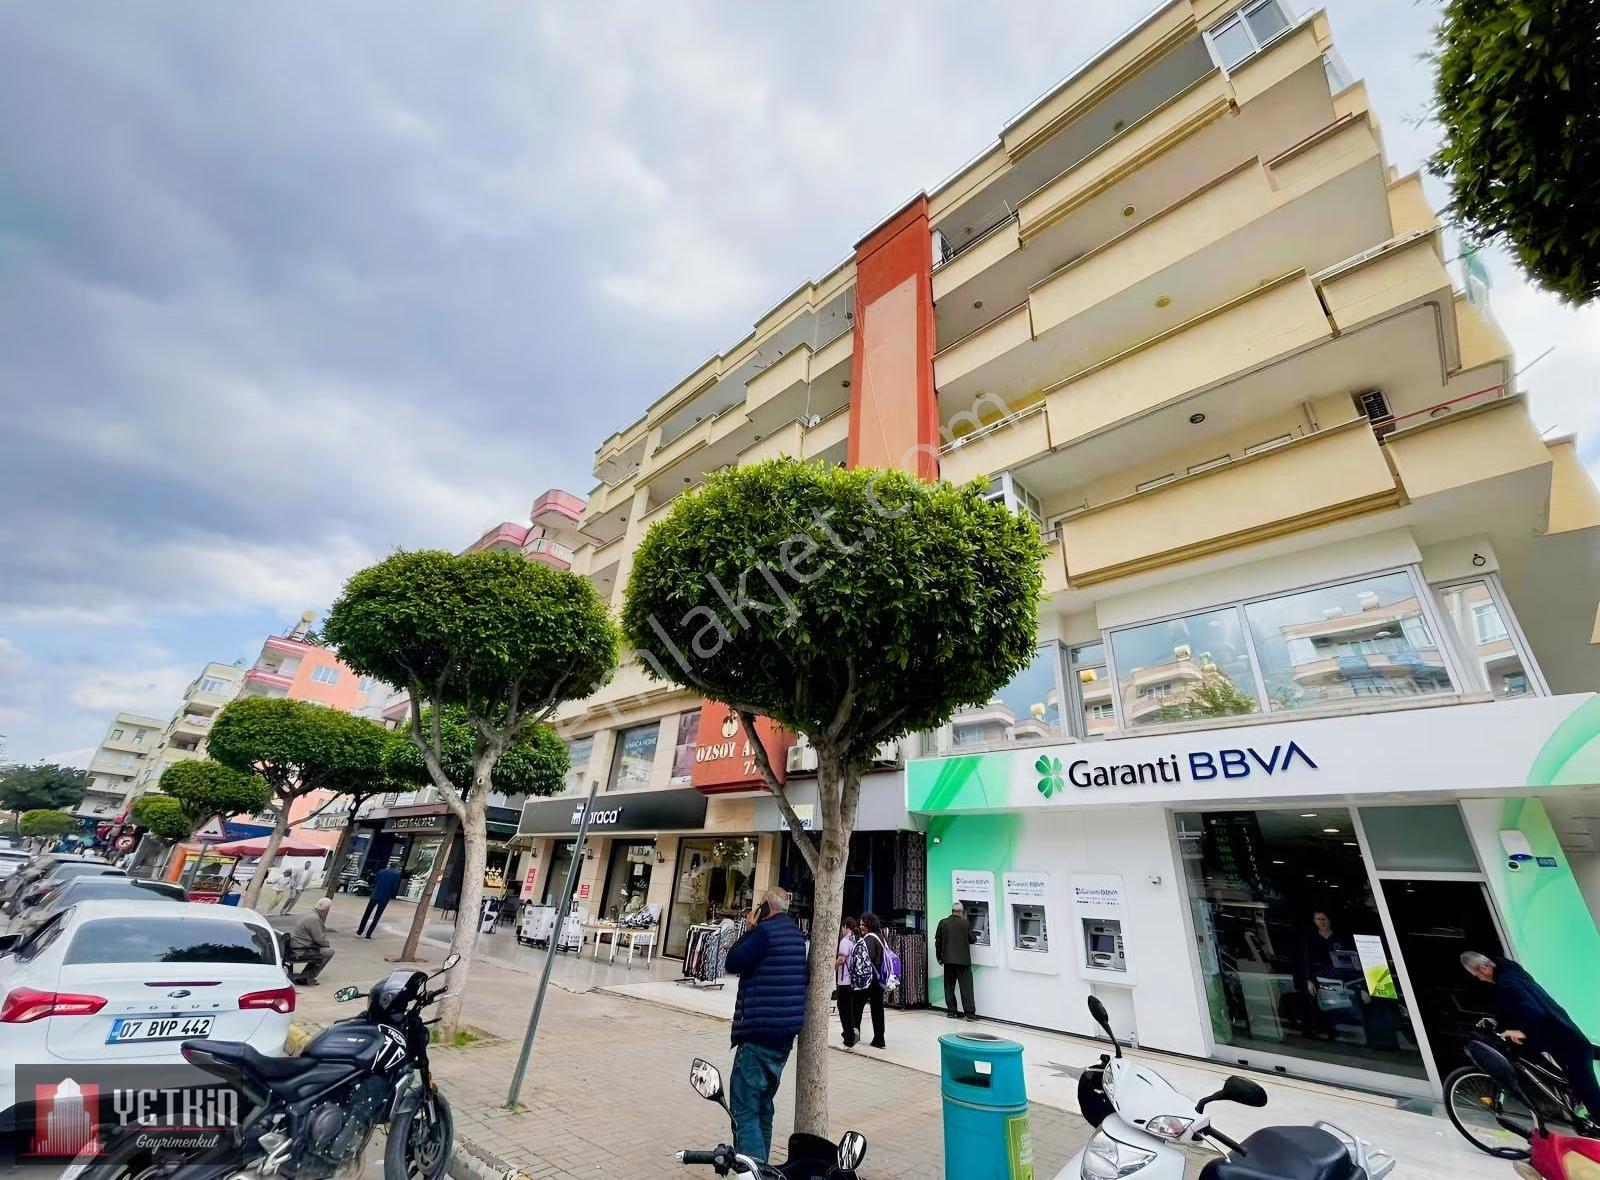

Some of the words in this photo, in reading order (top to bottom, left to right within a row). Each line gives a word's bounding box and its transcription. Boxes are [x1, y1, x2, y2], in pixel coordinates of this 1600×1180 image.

[1068, 754, 1181, 788] Garanti
[1188, 740, 1319, 781] BBVA
[120, 1022, 142, 1038] 07
[147, 1020, 178, 1036] BVP
[181, 1019, 210, 1035] 442
